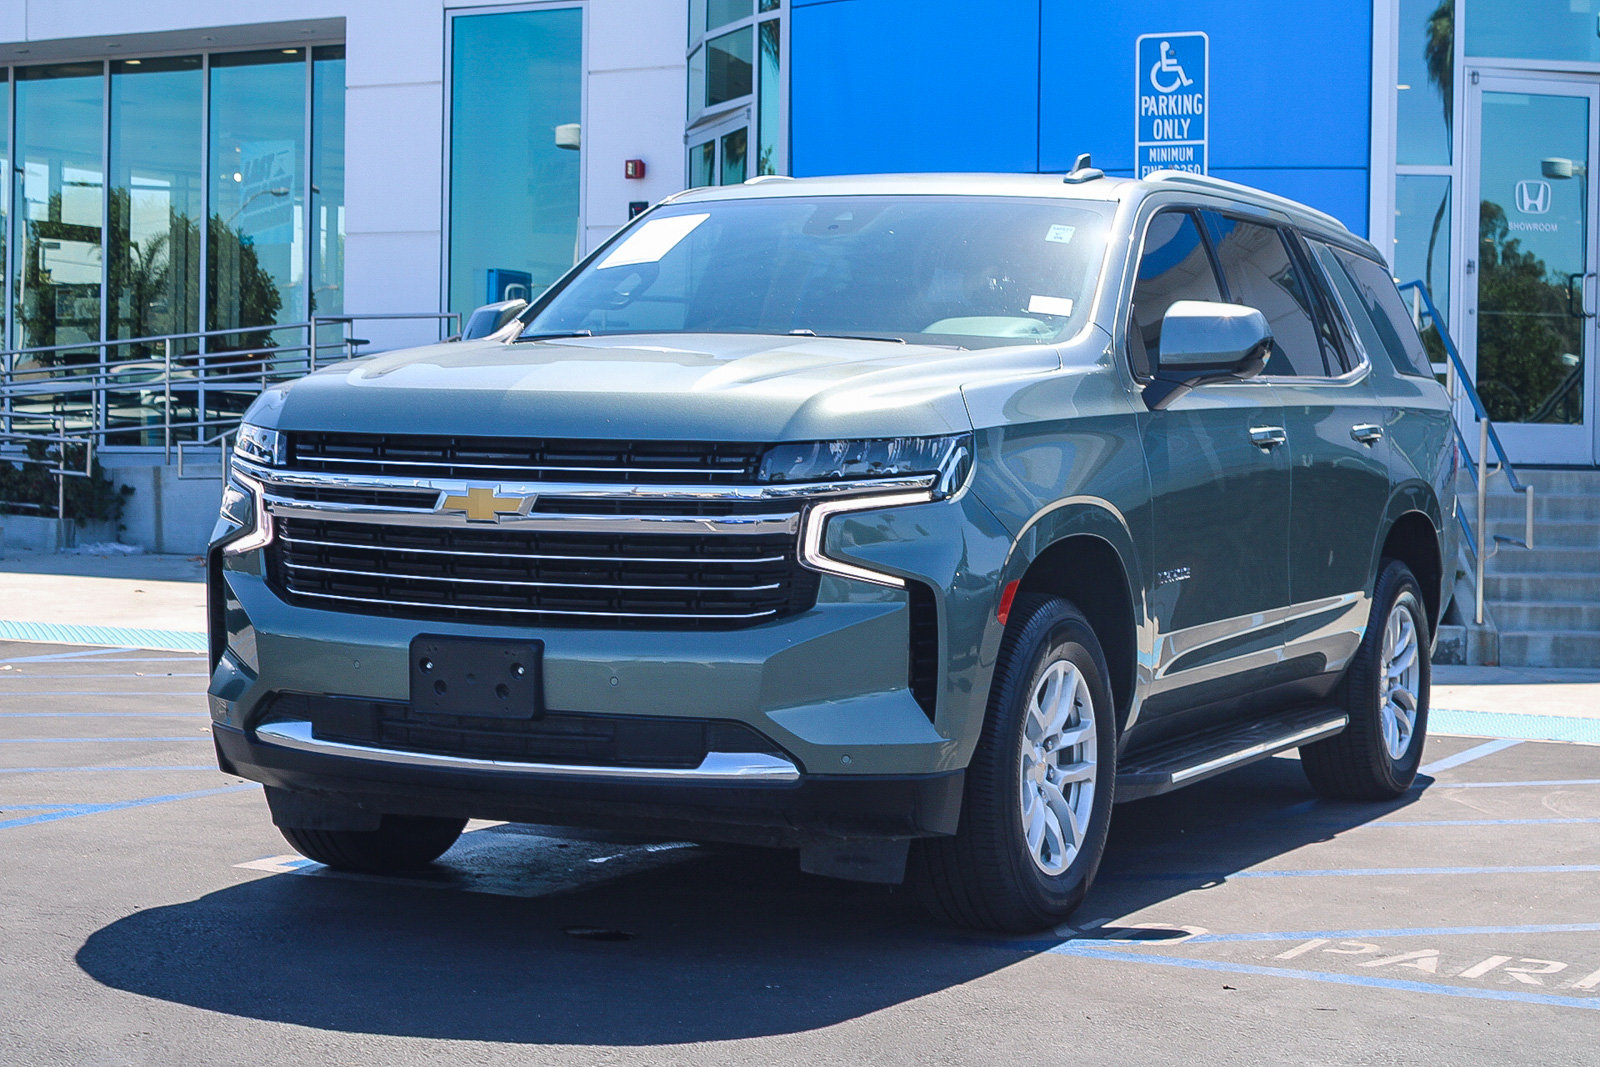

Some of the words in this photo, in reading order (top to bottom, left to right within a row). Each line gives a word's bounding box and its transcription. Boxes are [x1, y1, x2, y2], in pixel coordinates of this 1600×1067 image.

[1141, 93, 1203, 117] PARKING
[1153, 118, 1191, 140] ONLY
[1149, 147, 1194, 162] MINIMUM
[1508, 222, 1558, 232] SHOWROOM
